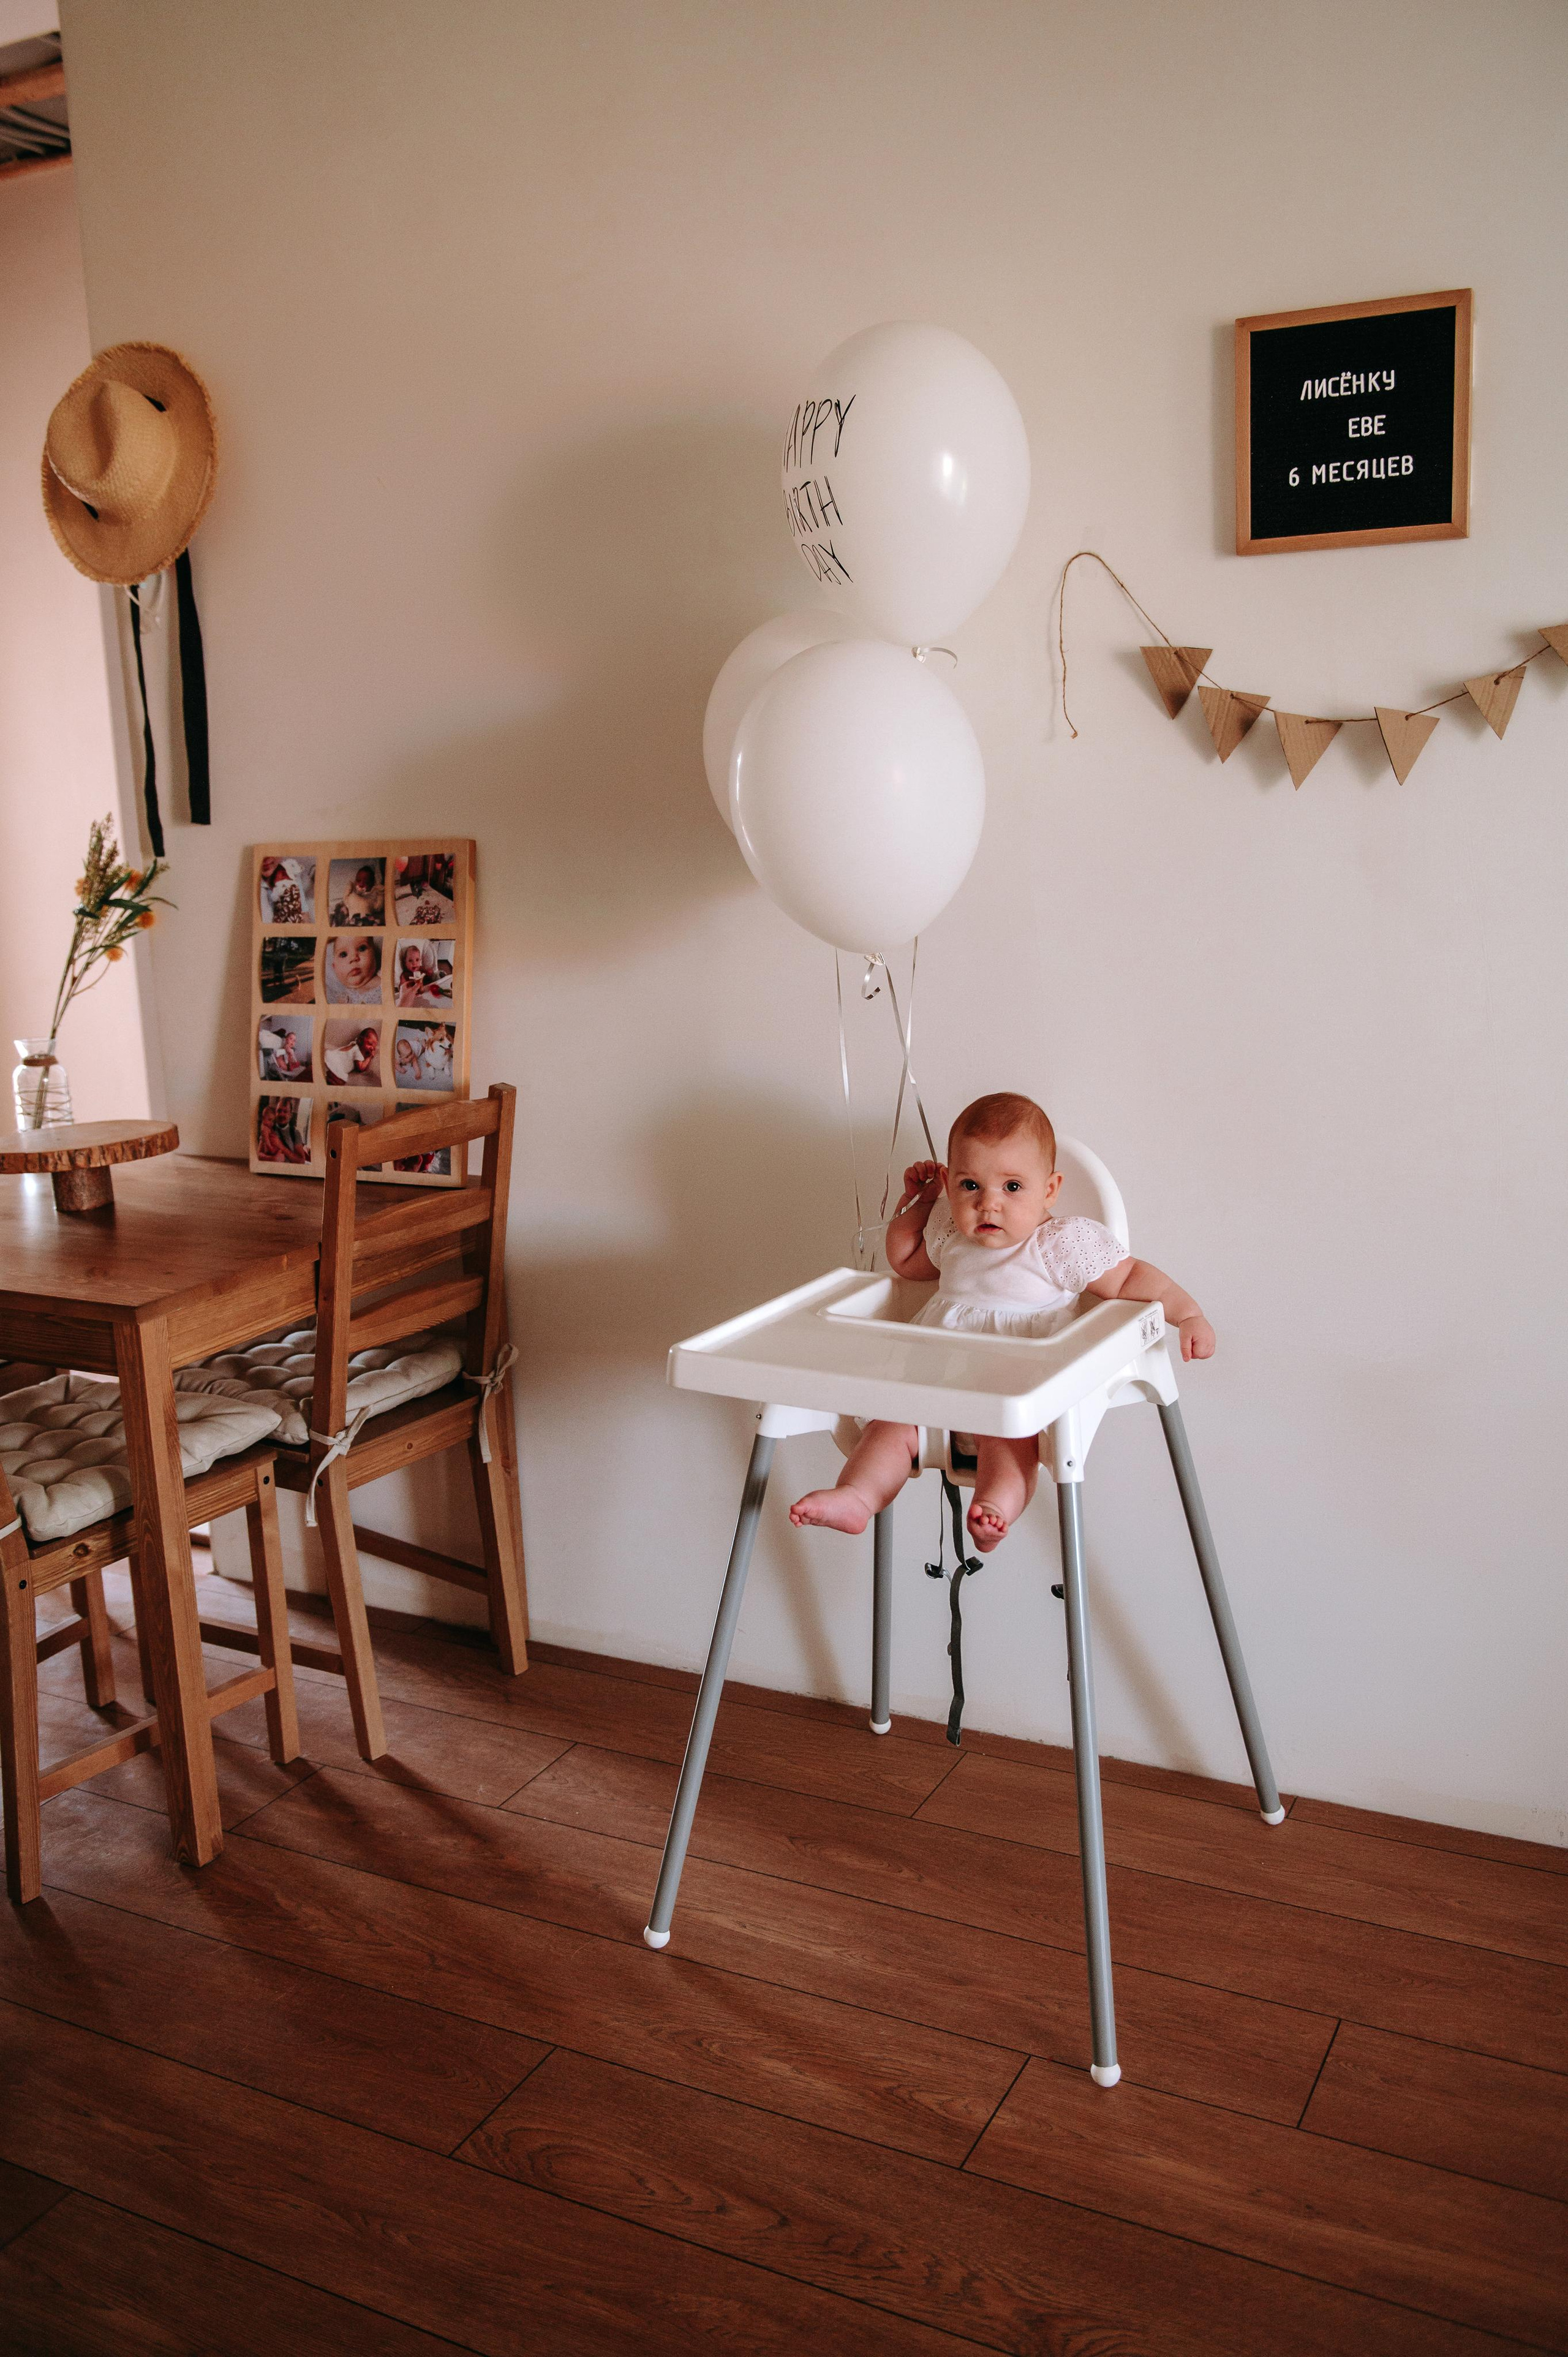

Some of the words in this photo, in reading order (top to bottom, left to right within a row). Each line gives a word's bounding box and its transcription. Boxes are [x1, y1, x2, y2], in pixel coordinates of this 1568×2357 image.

[1300, 369, 1395, 401] ЛИСЁНКУ
[1348, 414, 1386, 438] ЕВЕ
[1289, 467, 1300, 487] 6
[1312, 455, 1414, 485] МЕСЯЦЕВ
[801, 539, 853, 585] DAY
